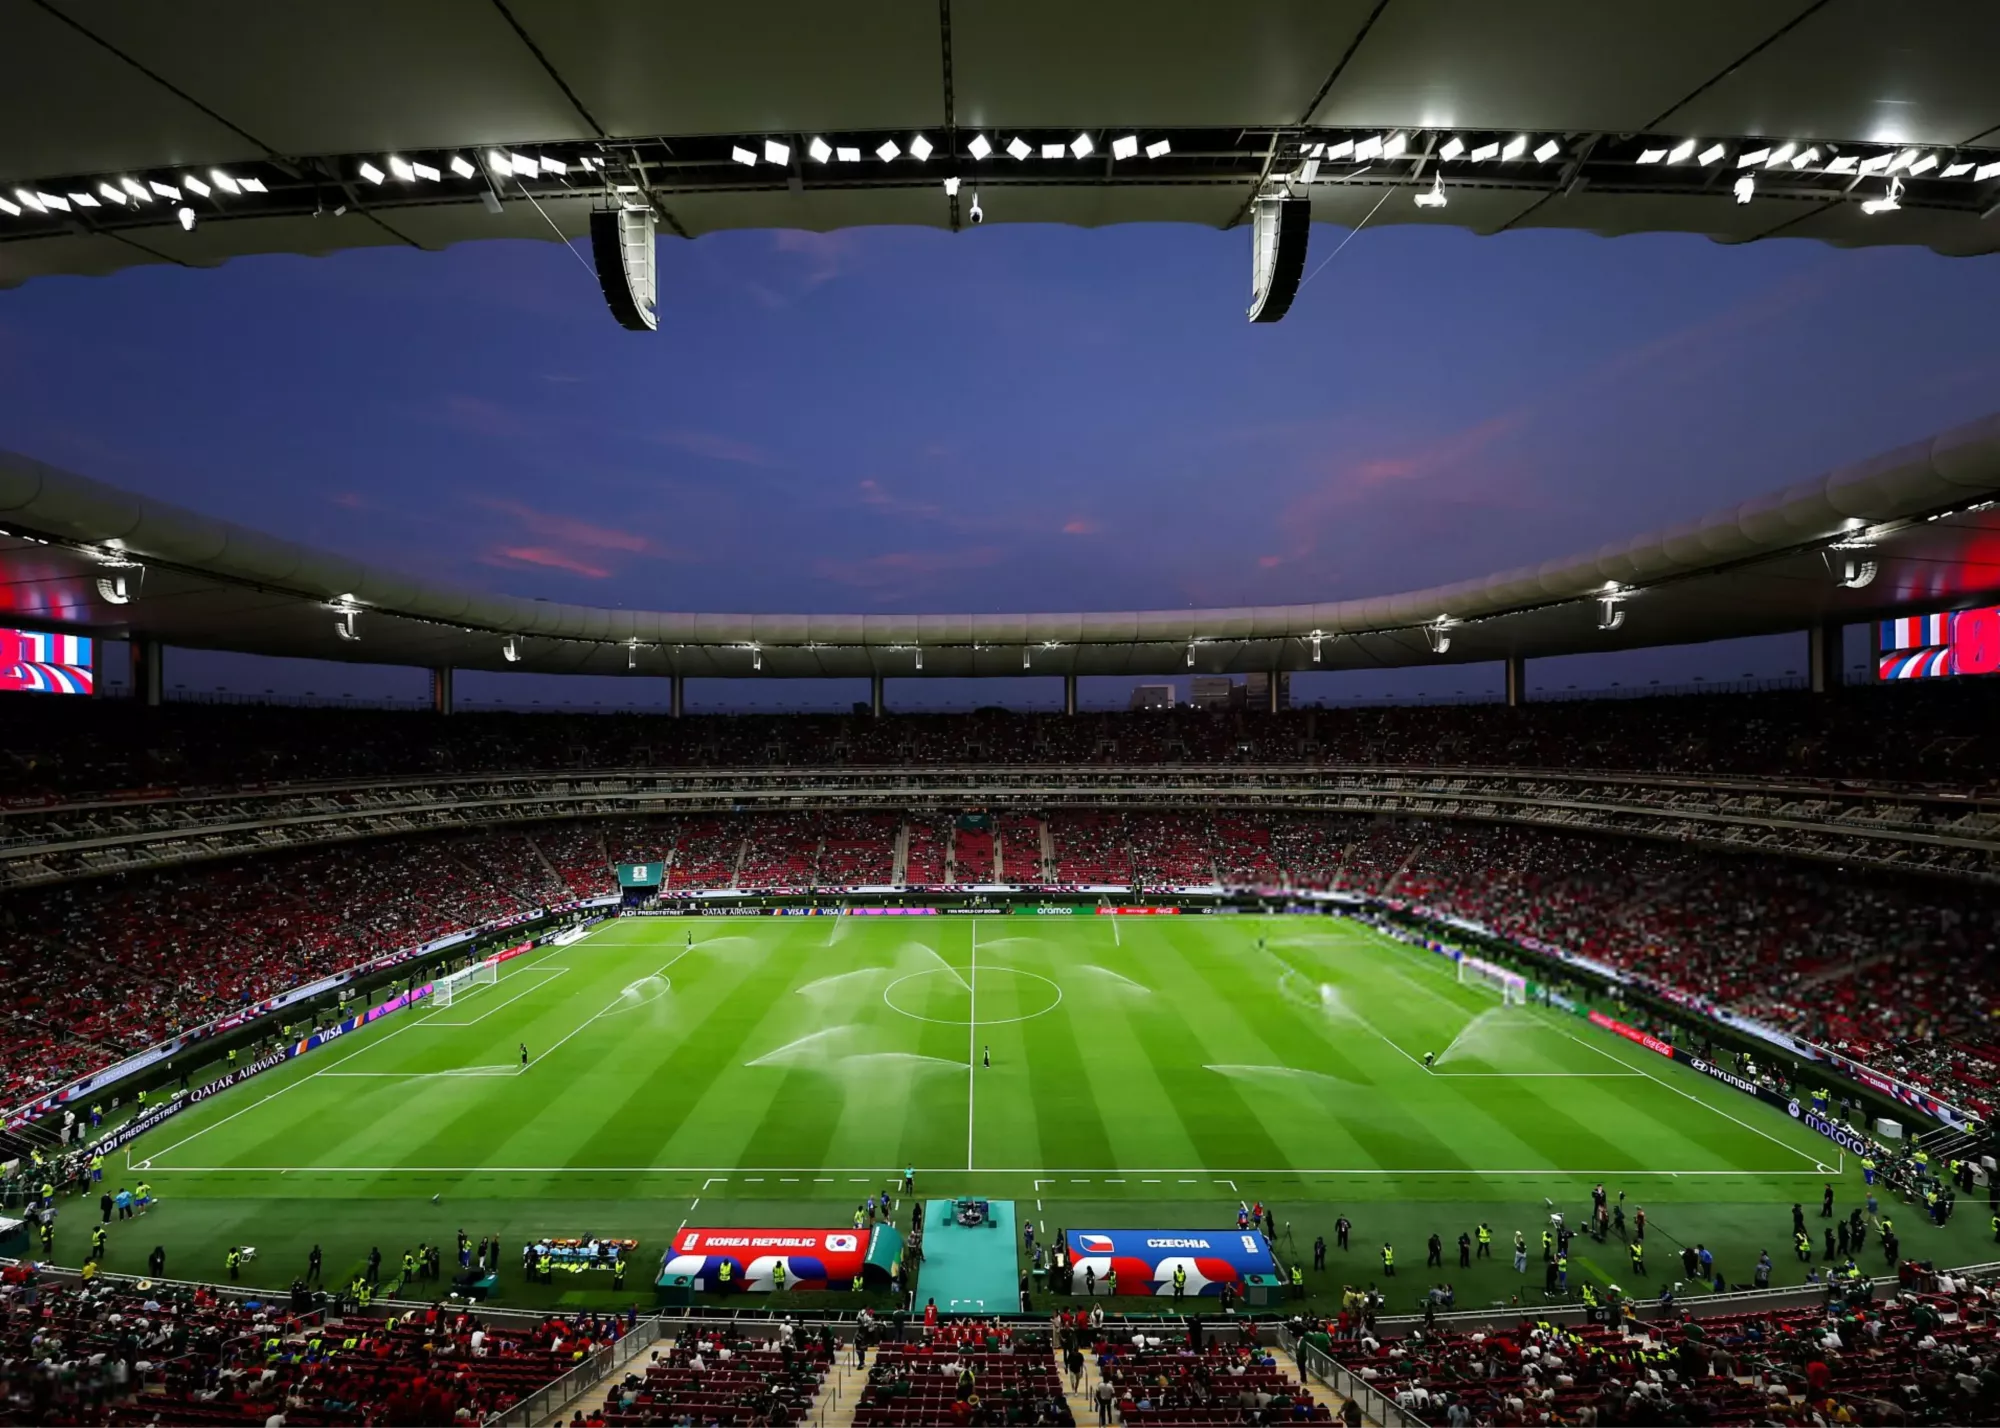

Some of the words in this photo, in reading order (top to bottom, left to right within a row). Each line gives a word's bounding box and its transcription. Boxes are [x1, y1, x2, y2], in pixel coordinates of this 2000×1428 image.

[318, 1024, 343, 1043] VISA
[191, 1074, 234, 1102] QATAR
[238, 1050, 286, 1081] AIRWAYS
[1710, 1066, 1756, 1095] HYUNDAI
[120, 1100, 183, 1143] PREDICTSTREET
[705, 1237, 749, 1246] KOREA
[751, 1238, 816, 1247] REPUBLIC
[1147, 1239, 1210, 1248] CZECHIA
[343, 1304, 350, 1312] H
[1595, 1311, 1603, 1320] G
